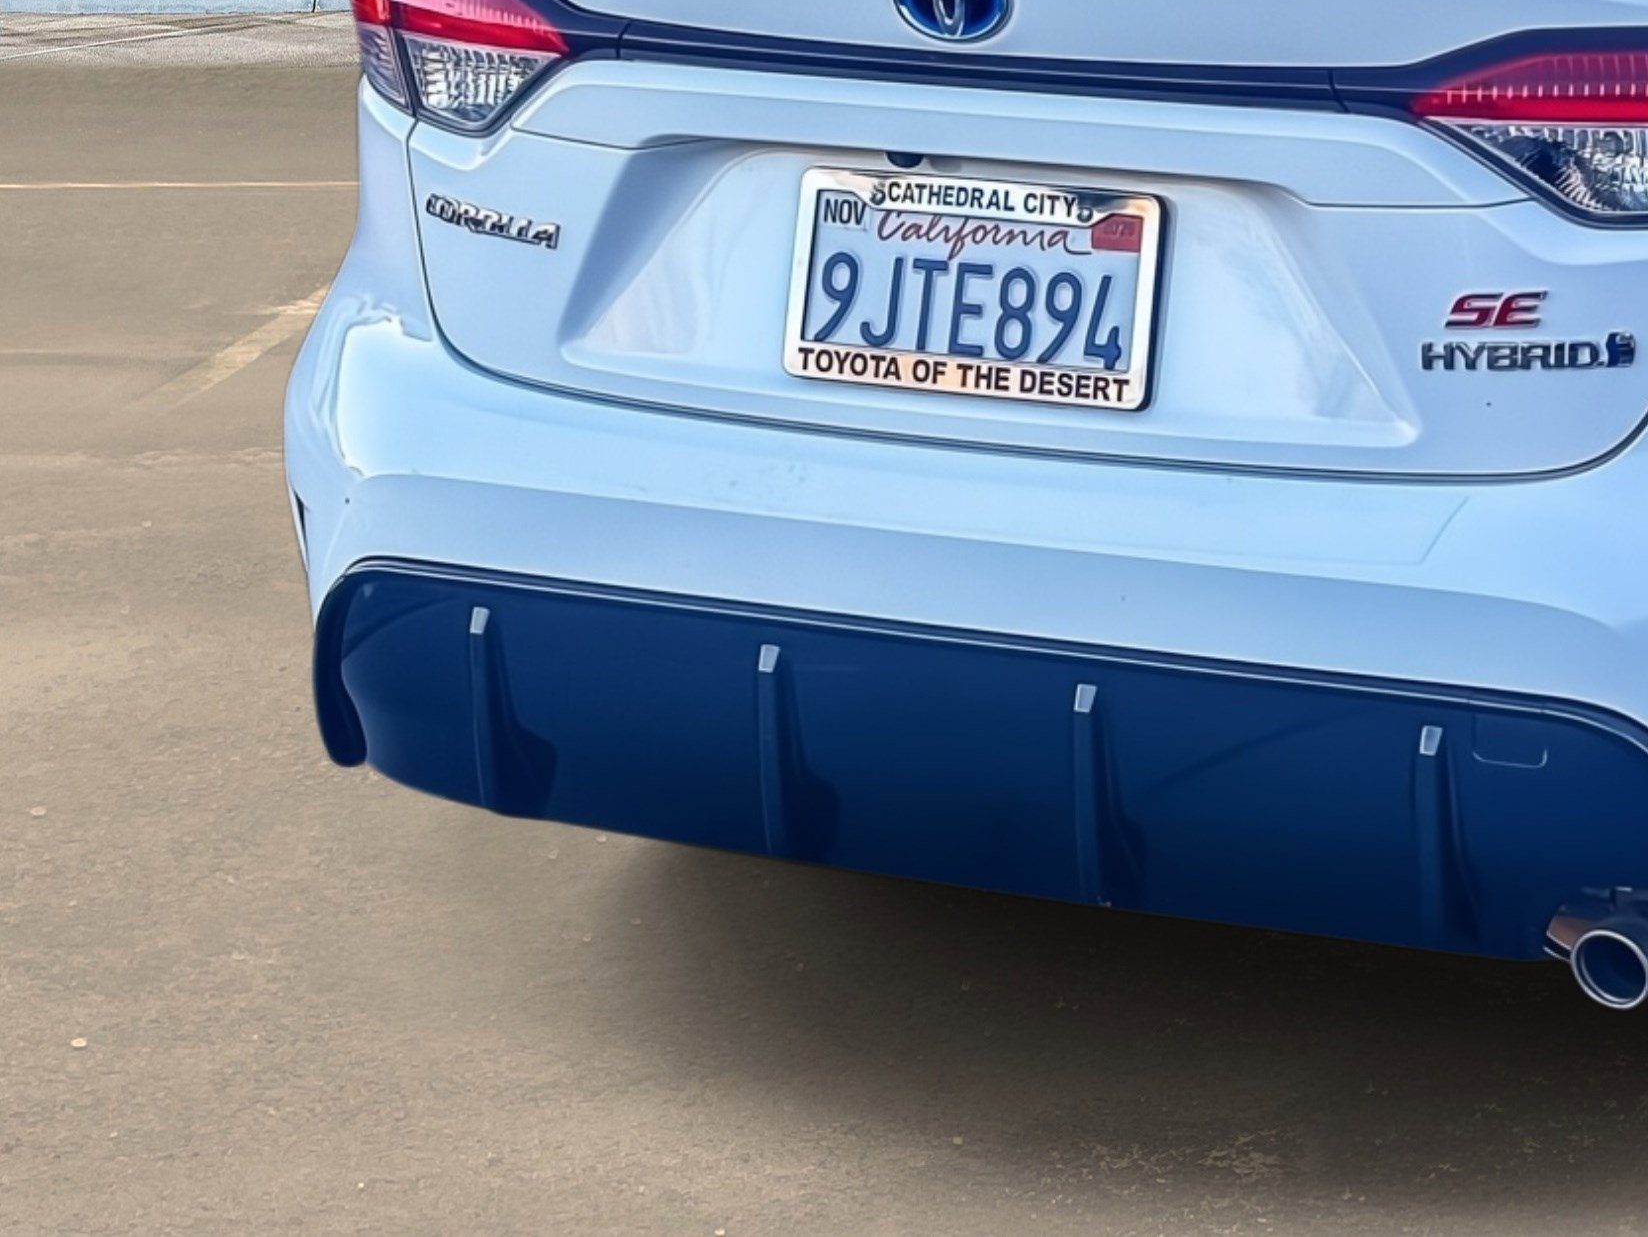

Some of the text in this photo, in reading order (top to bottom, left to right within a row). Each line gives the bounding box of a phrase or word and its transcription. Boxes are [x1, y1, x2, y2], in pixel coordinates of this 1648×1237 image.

[823, 198, 867, 227] NOV
[887, 180, 1078, 218] CATHEDRAL CITY
[877, 211, 1093, 261] California
[813, 252, 1123, 370] 9JTE894
[1444, 290, 1549, 329] SE
[798, 346, 1131, 403] TOYOTA OF THE DESERT
[1420, 340, 1600, 371] HYBRID
